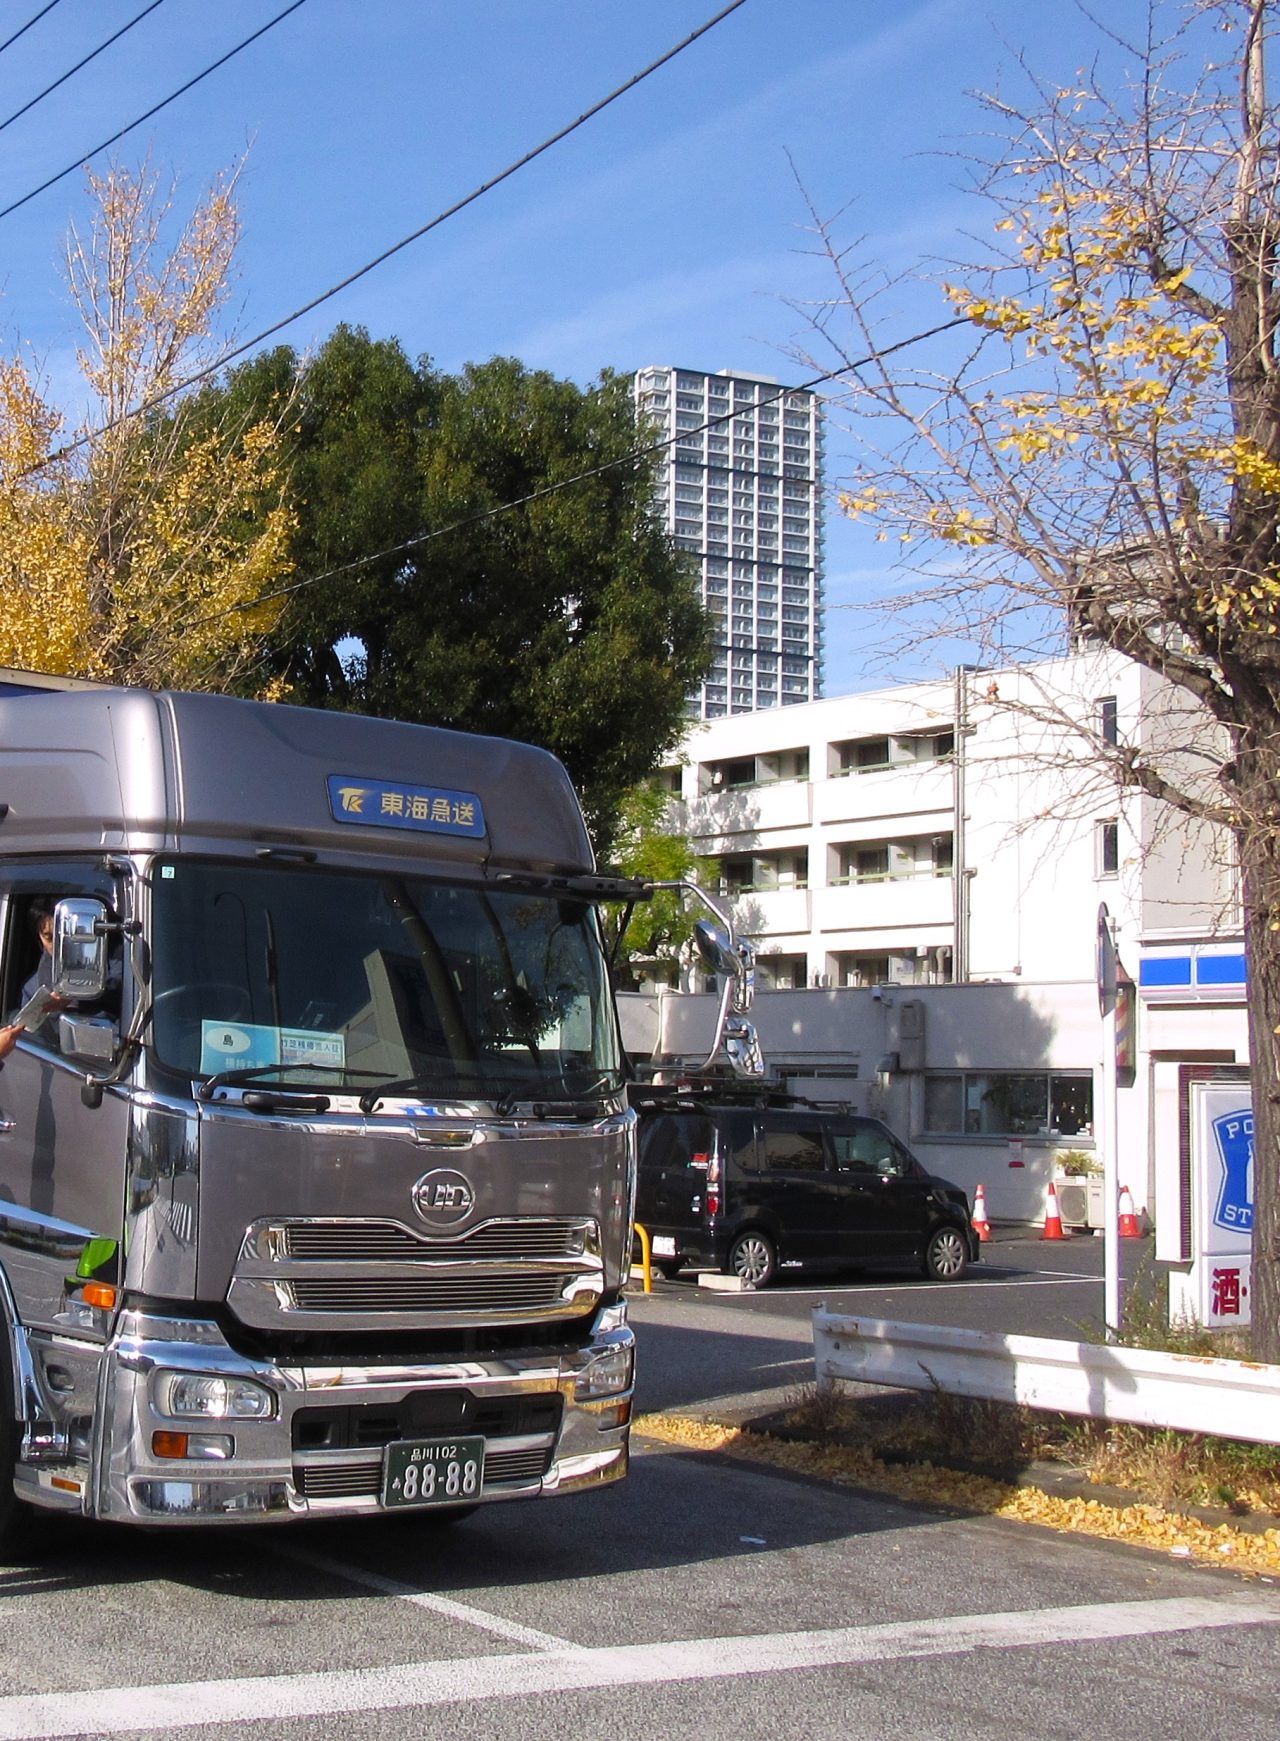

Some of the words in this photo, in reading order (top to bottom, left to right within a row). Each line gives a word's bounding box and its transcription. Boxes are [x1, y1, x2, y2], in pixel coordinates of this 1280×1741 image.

[381, 793, 474, 826] 東海急送
[1226, 1119, 1254, 1139] PO
[1224, 1204, 1252, 1224] ST
[403, 1460, 477, 1499] 88-88
